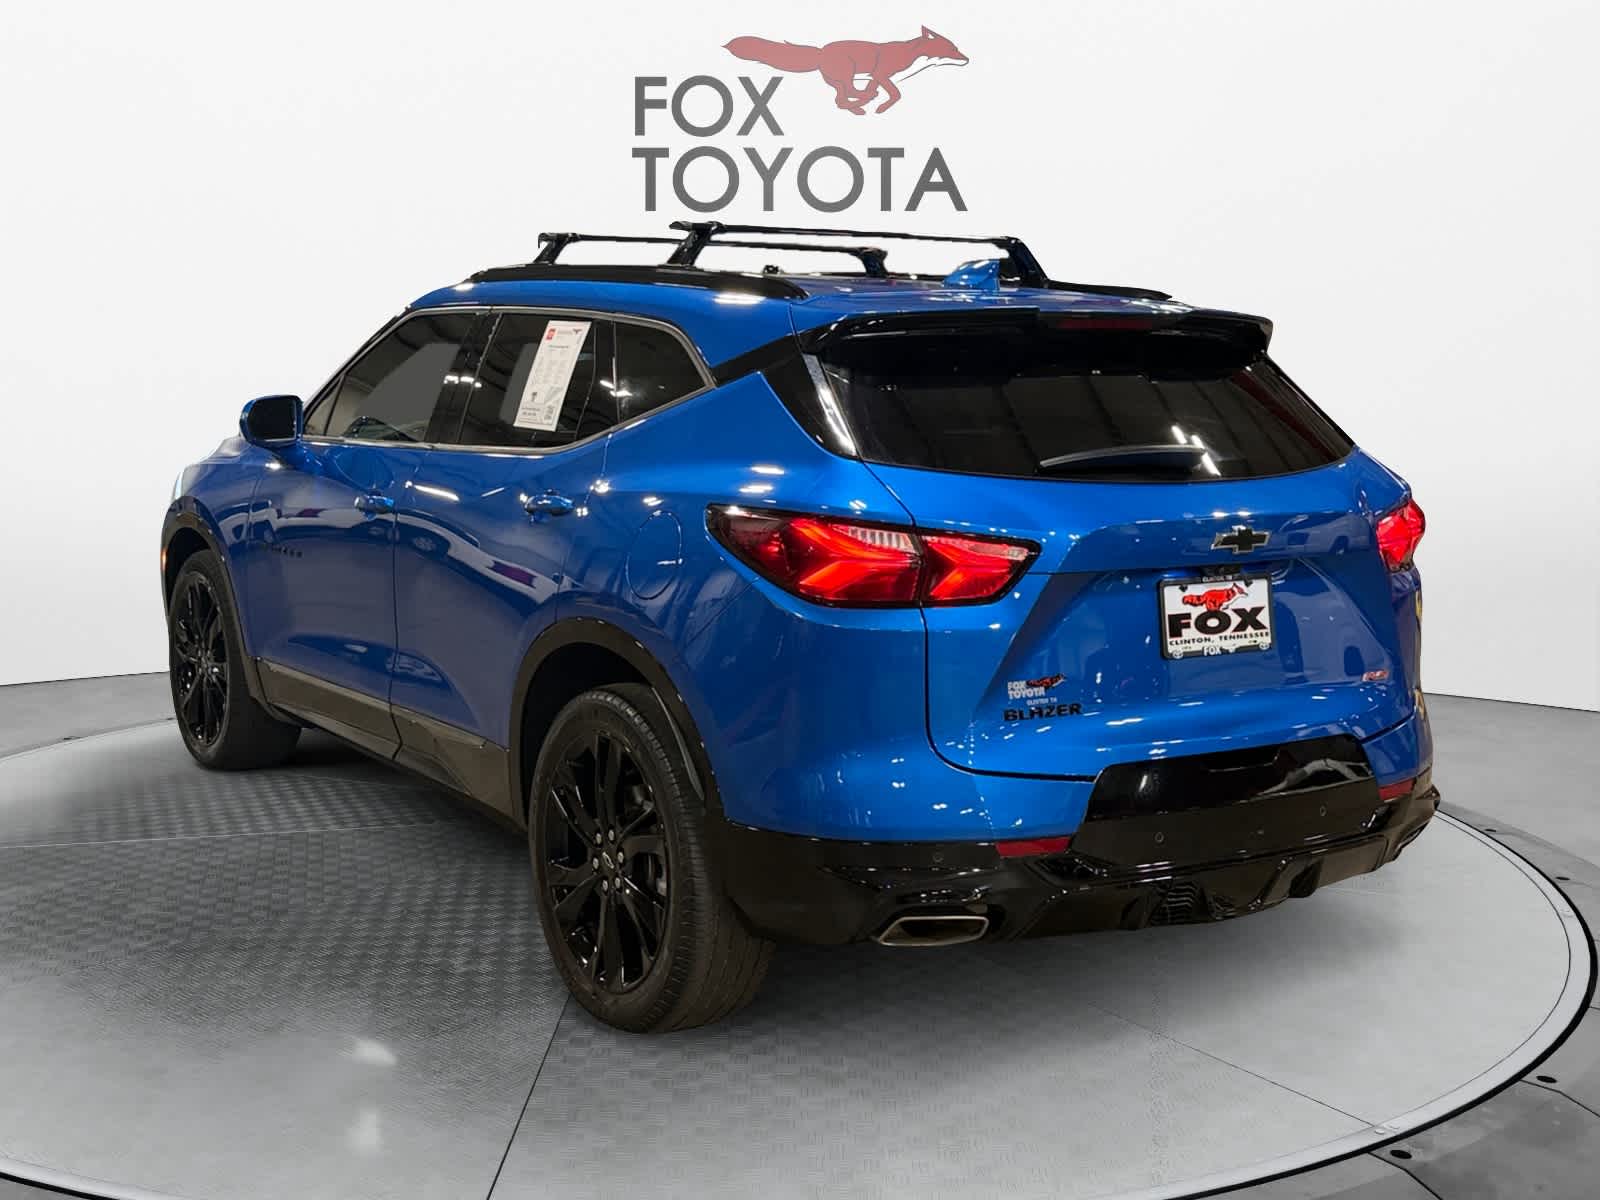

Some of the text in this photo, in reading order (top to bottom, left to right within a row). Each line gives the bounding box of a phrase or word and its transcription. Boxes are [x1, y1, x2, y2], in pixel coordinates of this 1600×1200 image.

[1168, 607, 1267, 637] FOX
[1169, 632, 1270, 646] CLINTON, TENNESSEE
[1204, 647, 1221, 656] FOX
[1008, 681, 1026, 690] FOX
[1007, 687, 1045, 700] TOYOTA
[1004, 704, 1081, 721] BLAZER
